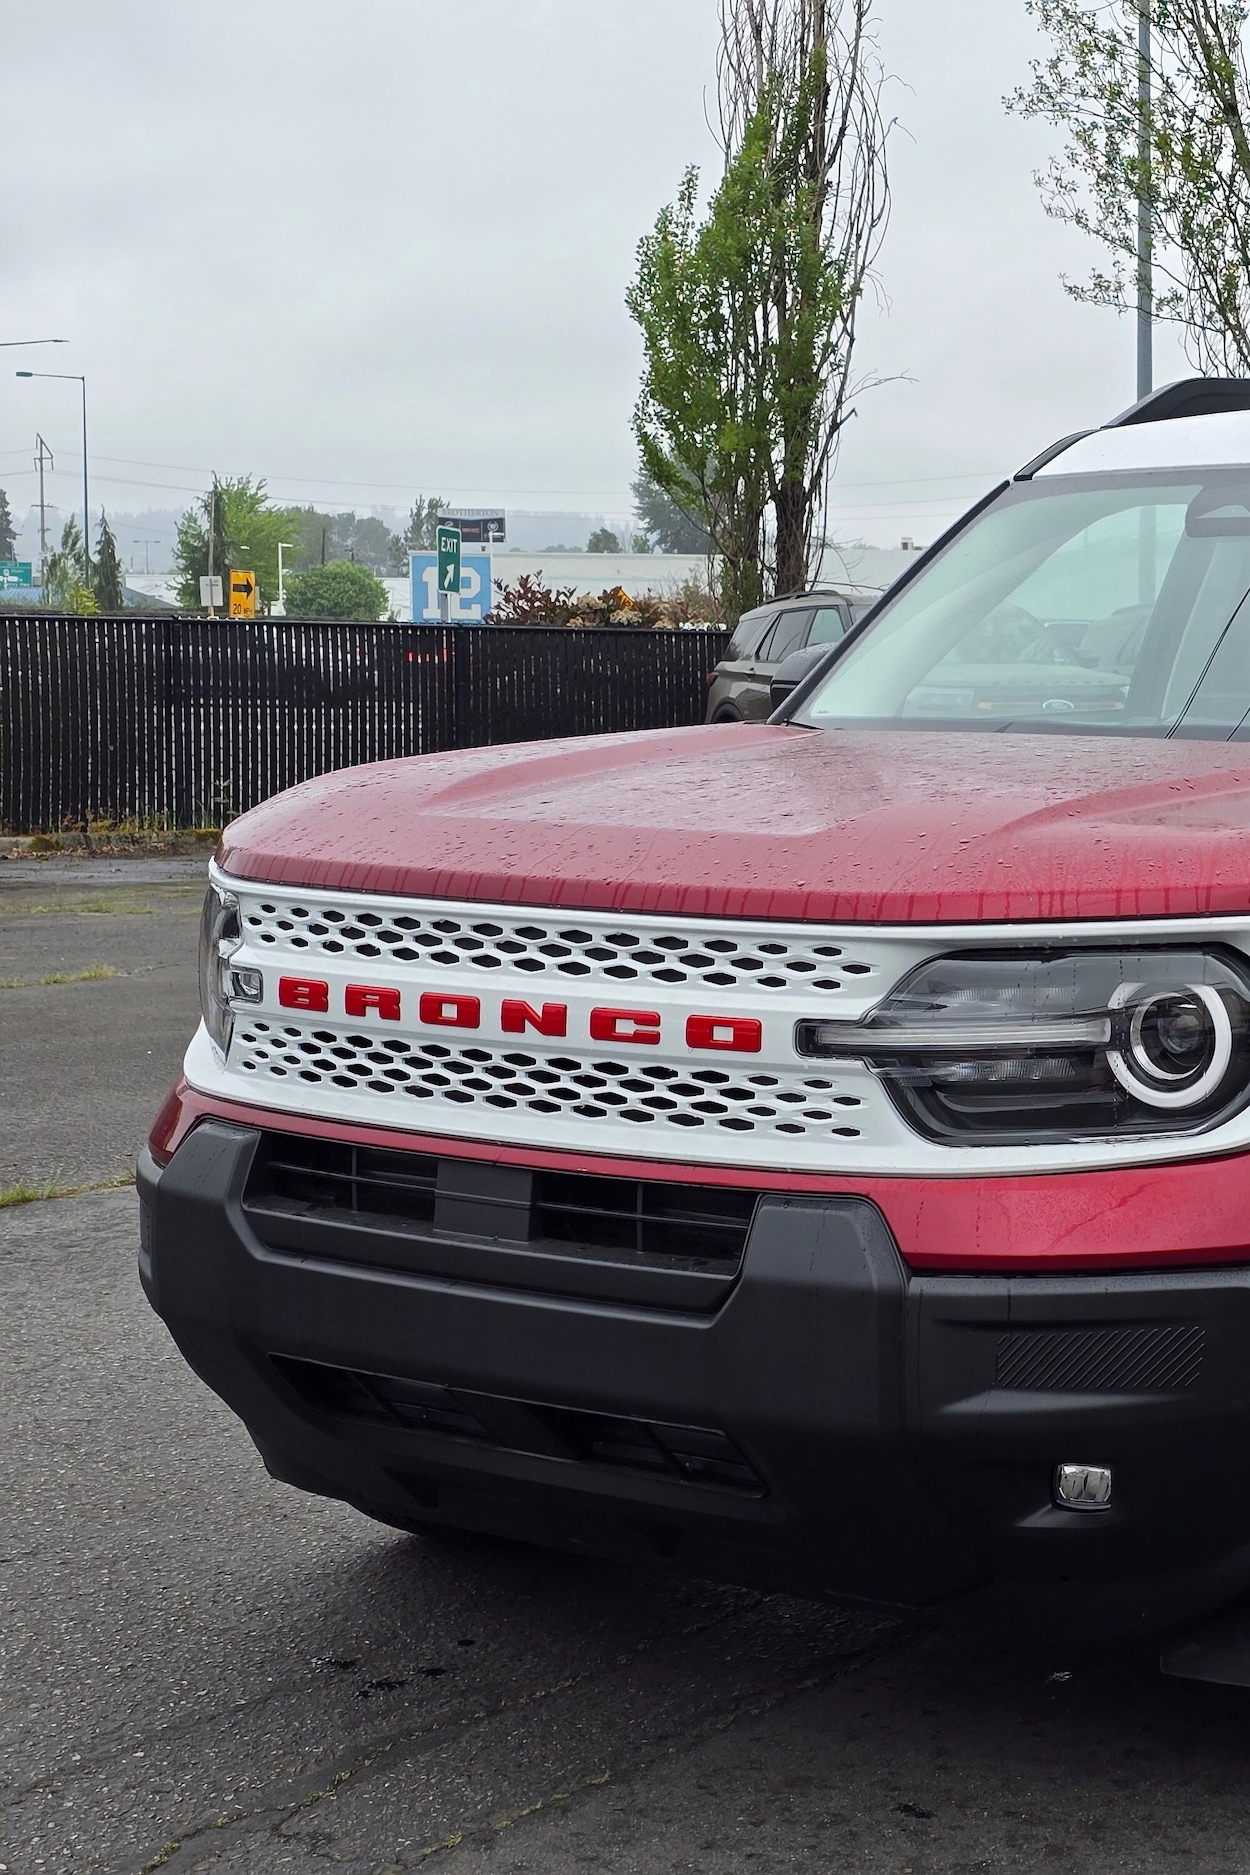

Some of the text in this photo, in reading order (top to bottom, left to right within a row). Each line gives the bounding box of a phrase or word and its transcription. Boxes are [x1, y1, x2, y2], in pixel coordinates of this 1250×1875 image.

[442, 509, 500, 517] BROTHERTON
[441, 537, 458, 553] EXIT
[233, 603, 242, 615] 20
[279, 976, 762, 1053] BRONCO
